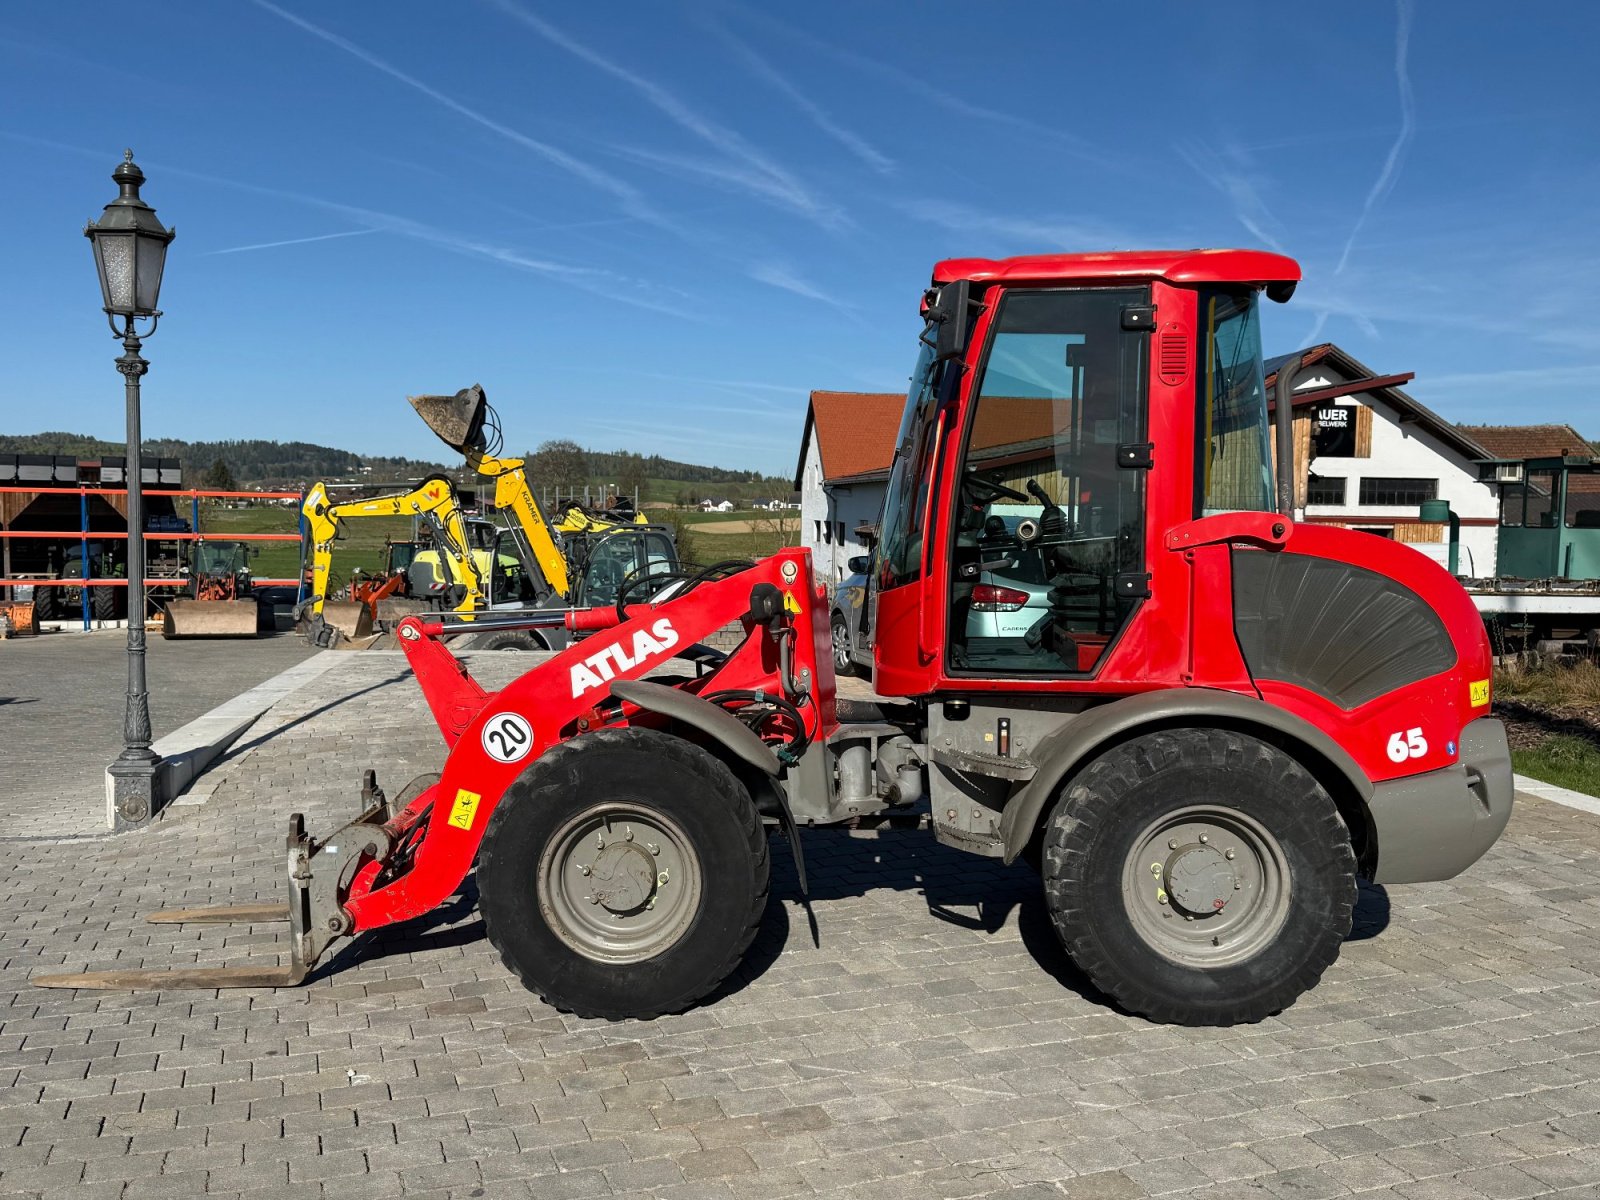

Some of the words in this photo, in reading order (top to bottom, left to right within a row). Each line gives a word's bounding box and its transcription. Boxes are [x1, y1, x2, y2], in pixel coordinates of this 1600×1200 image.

[521, 490, 540, 525] KRAMER
[569, 618, 679, 700] ATLAS
[488, 718, 528, 759] 20
[1386, 726, 1429, 763] 65
